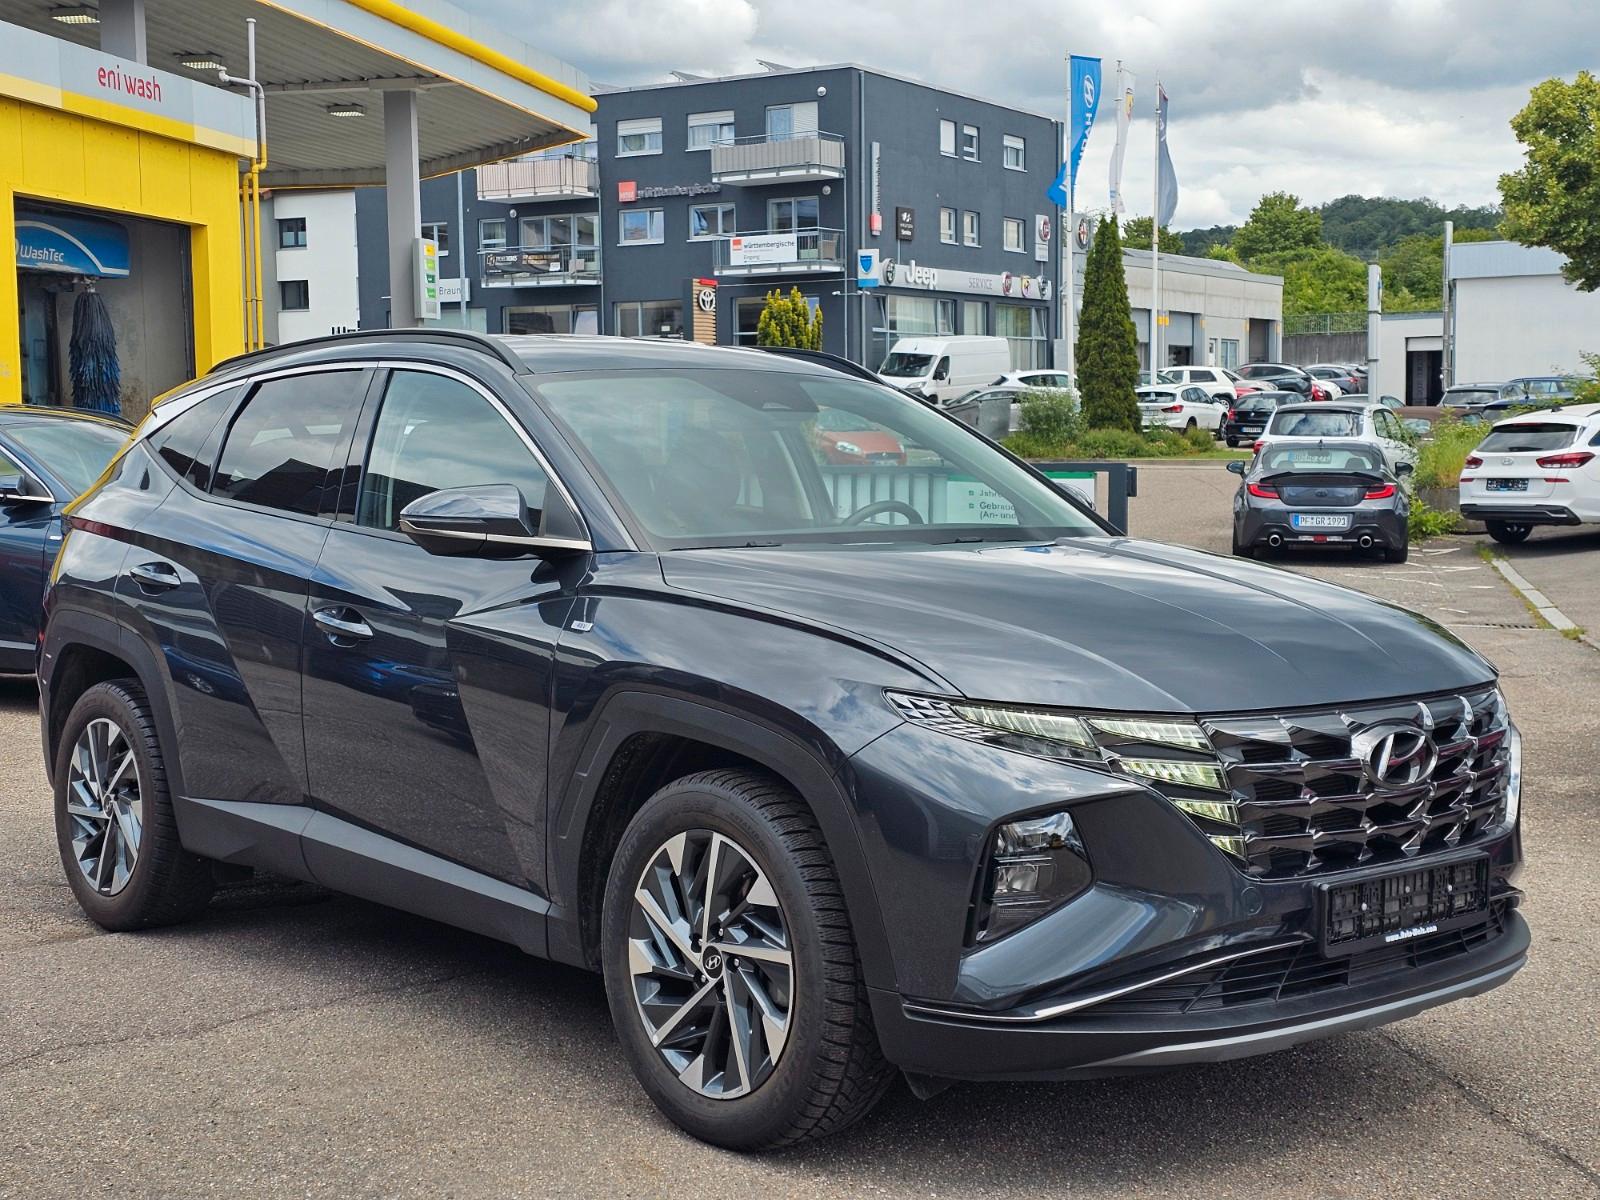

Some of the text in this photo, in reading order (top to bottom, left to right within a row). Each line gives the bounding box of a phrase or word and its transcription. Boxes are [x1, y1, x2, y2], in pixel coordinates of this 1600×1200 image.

[97, 64, 162, 103] eni wash
[743, 241, 795, 249] württembergische
[20, 244, 65, 262] WashTec
[905, 259, 938, 290] Jeep
[968, 277, 993, 290] SERVICE
[1315, 516, 1326, 525] GR
